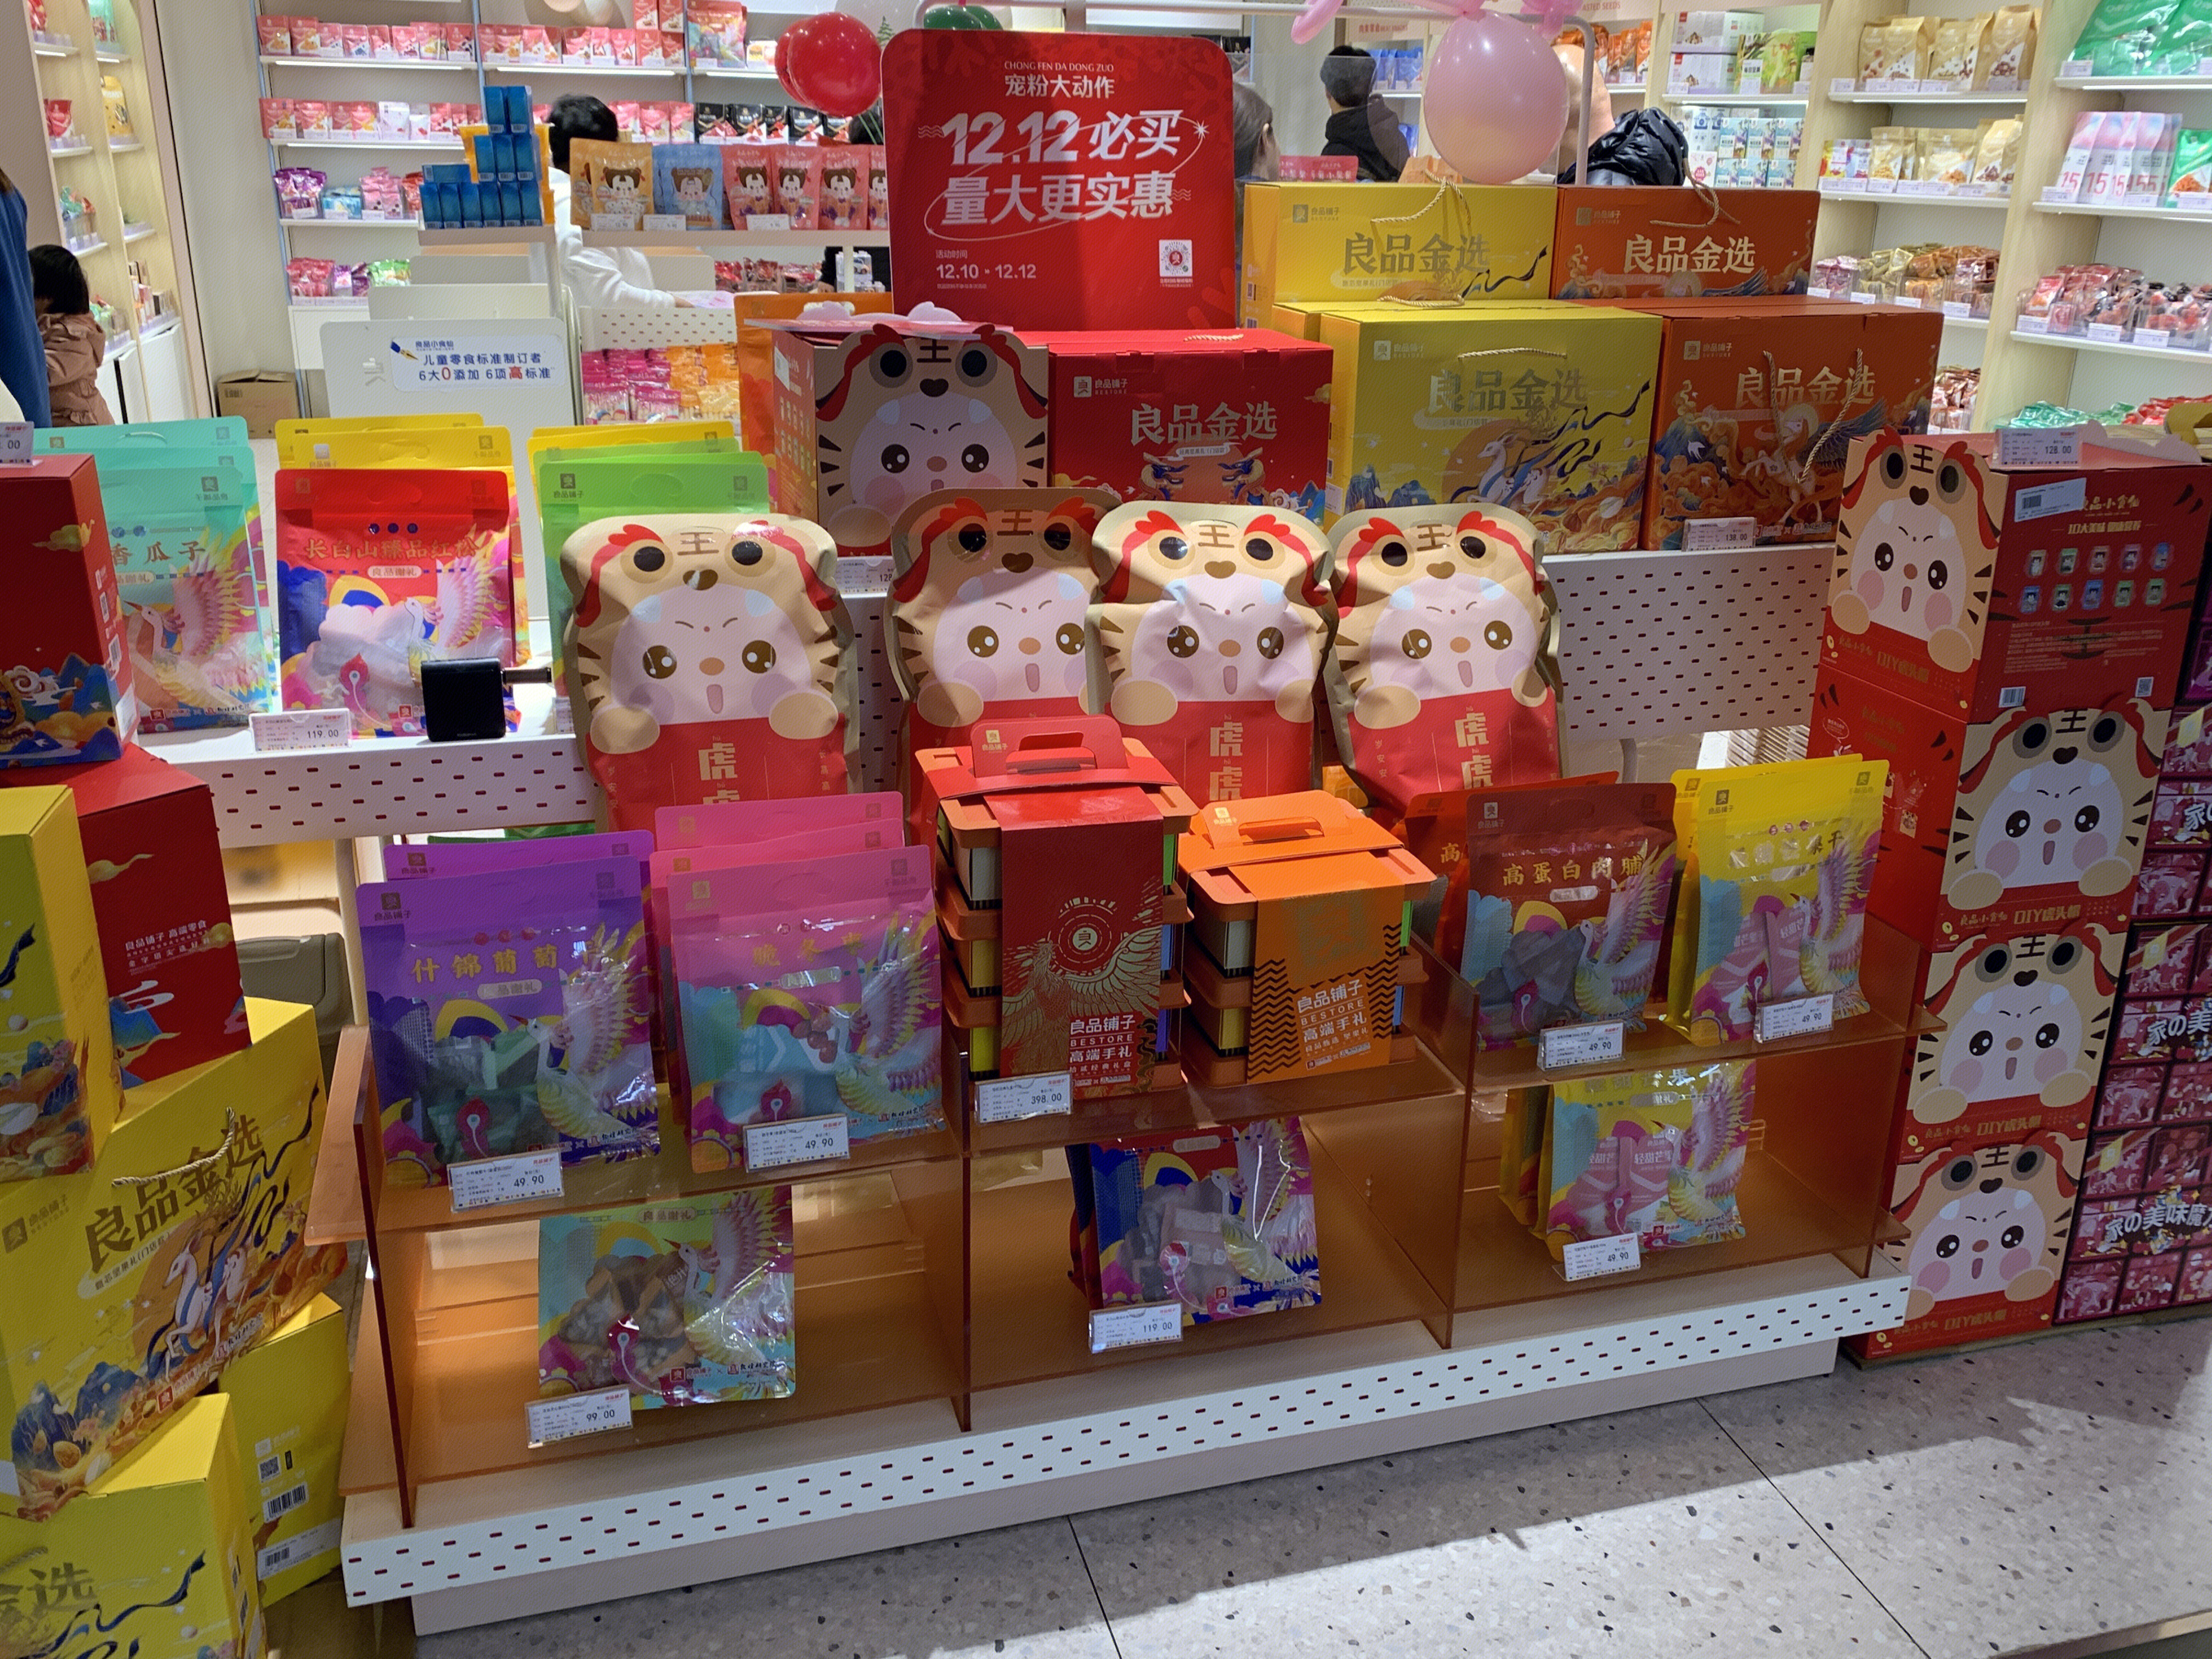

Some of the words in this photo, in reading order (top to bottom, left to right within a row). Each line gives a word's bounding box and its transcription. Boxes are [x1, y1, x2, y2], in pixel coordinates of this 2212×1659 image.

[1004, 61, 1035, 71] CHONG
[1038, 61, 1053, 71] FEN
[1055, 62, 1068, 72] DA
[1069, 62, 1094, 72] DONG
[1096, 63, 1114, 72] ZUO
[1004, 75, 1115, 98] 宠粉大动作
[941, 171, 1176, 226] 量大更实惠
[935, 249, 968, 259] 活动时间
[1343, 232, 1491, 275] 良品金选
[1622, 234, 1756, 275] 良品金选
[936, 264, 979, 279] 12.10
[995, 264, 1037, 279] 12.12
[424, 352, 541, 365] 儿童零食标准制订者
[1428, 367, 1589, 415] 良品金选
[1735, 365, 1876, 409] 良品金选
[1131, 400, 1278, 446] 良品金选
[2045, 445, 2072, 454] 128.00
[307, 729, 339, 740] 119.00
[1210, 721, 1244, 757] 虎
[698, 741, 738, 781] 虎
[1209, 765, 1244, 801] 虎
[1297, 979, 1363, 1013] 良品铺子
[1301, 998, 1364, 1026] BESTORE
[1802, 1013, 1822, 1023] 49.90
[1070, 1014, 1136, 1035] 良品铺子
[1304, 1011, 1367, 1043] 高端手礼
[1070, 1034, 1133, 1047] BESTORE
[1589, 1041, 1612, 1051] 49.90
[1070, 1045, 1132, 1063] 高端手礼
[1031, 1093, 1062, 1105] 398.00
[805, 1138, 834, 1149] 49.90
[514, 1174, 544, 1187] 49.90
[1607, 1251, 1629, 1262] 49.90
[1143, 1322, 1172, 1333] 119.00
[586, 1409, 615, 1423] 99.00
